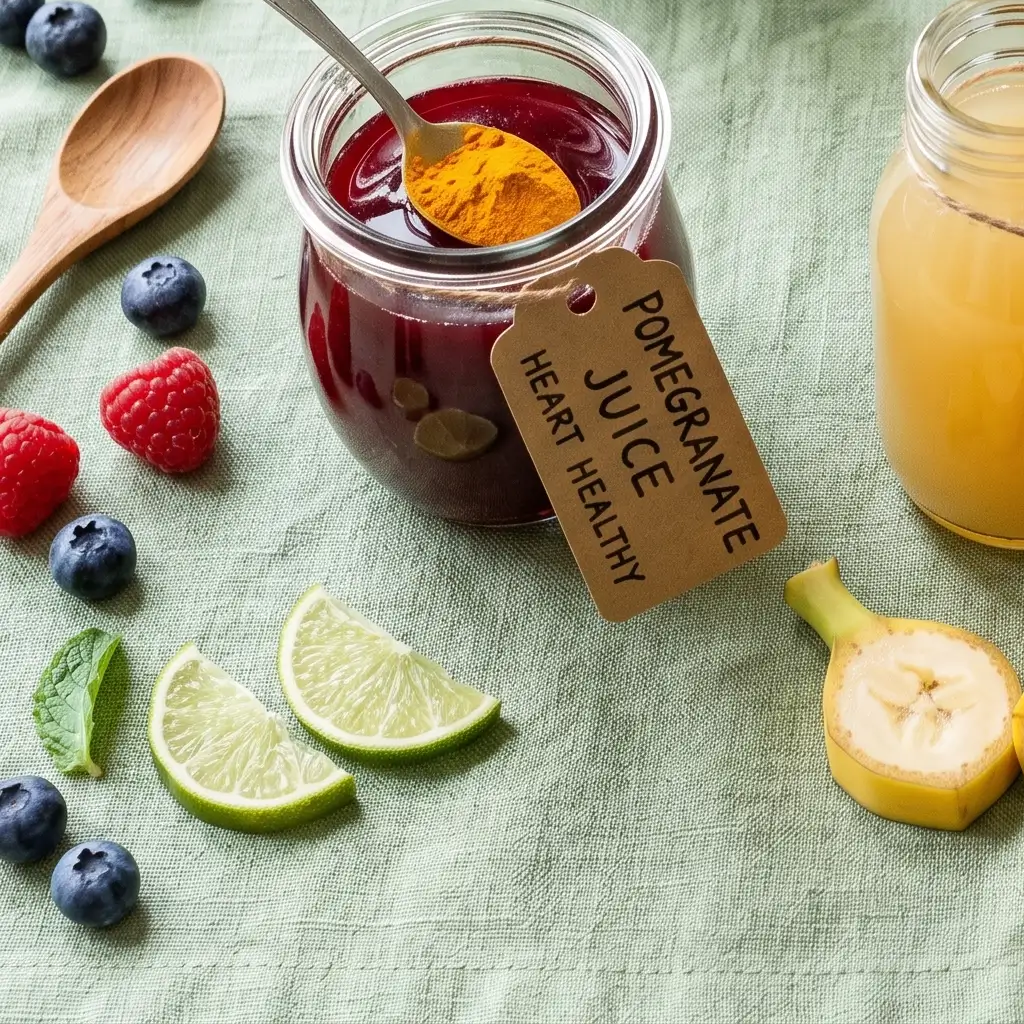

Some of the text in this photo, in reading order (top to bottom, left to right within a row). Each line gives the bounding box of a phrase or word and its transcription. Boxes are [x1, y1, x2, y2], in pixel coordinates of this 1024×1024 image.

[520, 348, 646, 585] HEART HEALTHY
[584, 369, 674, 498] JUICE
[622, 289, 761, 554] POMEGRANATE
